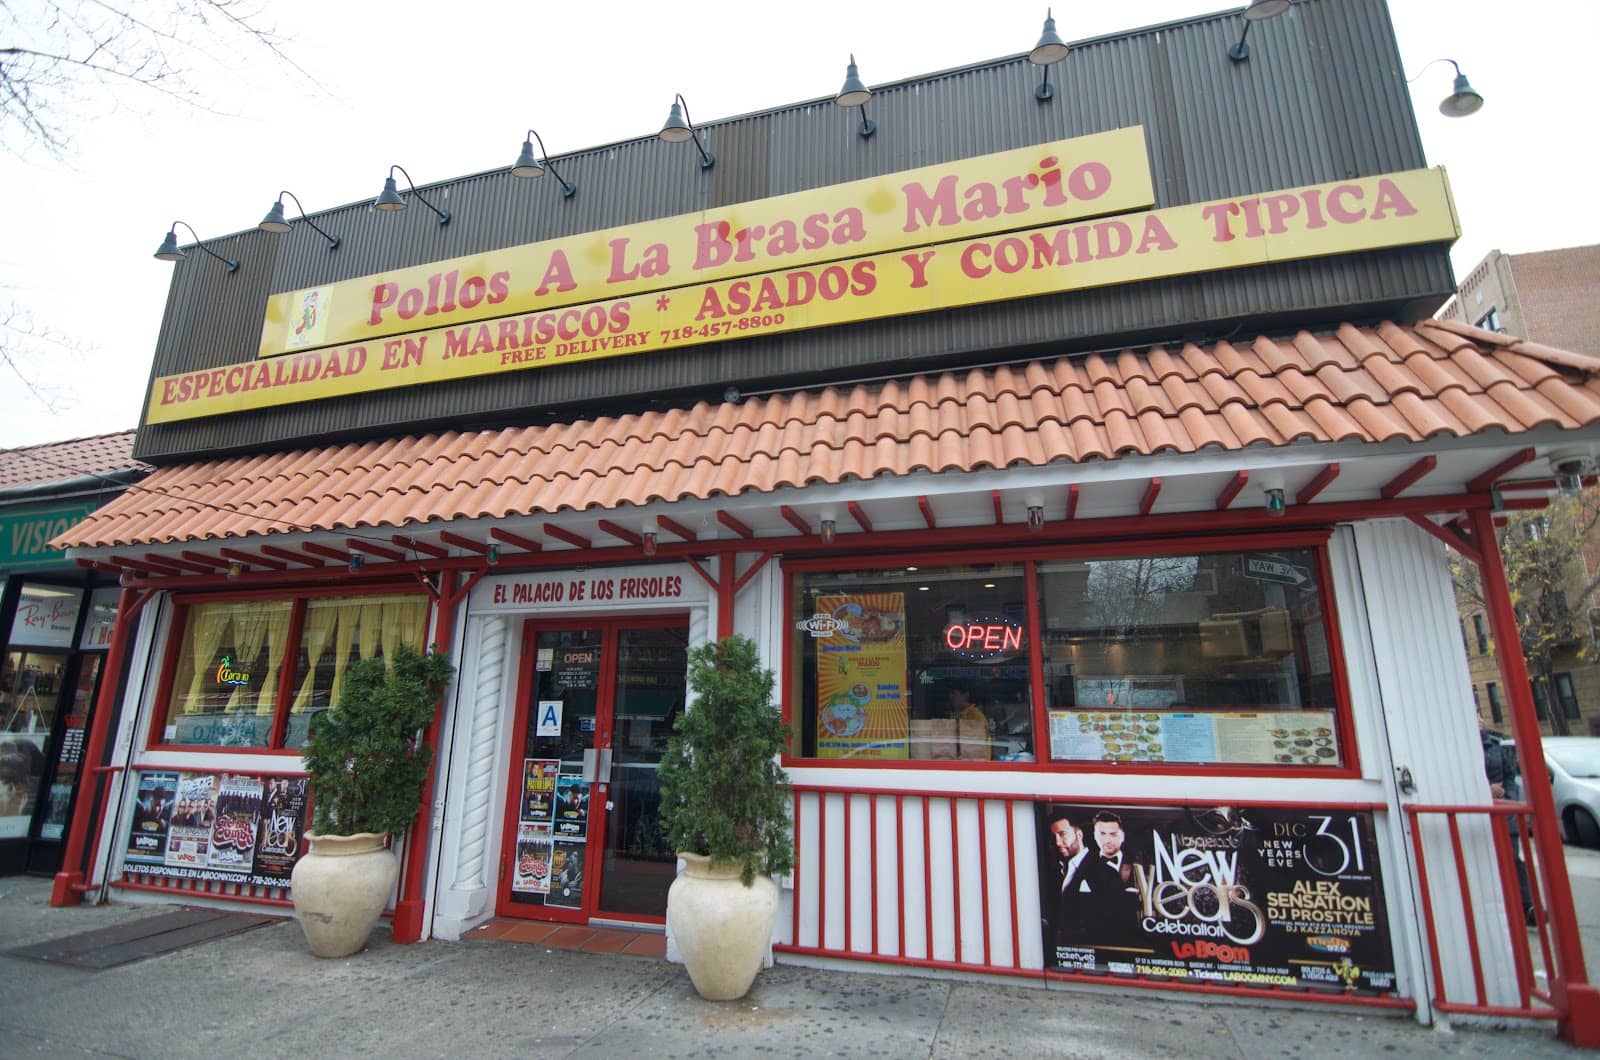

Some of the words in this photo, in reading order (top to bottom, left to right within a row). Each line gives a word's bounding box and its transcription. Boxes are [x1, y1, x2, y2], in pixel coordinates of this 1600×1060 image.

[368, 269, 510, 327] Pollos
[535, 249, 578, 297] A
[606, 238, 670, 284] La
[692, 206, 867, 271] Brasa
[902, 156, 1112, 233] Mario
[160, 346, 367, 405] ESPECIALIDAD
[380, 336, 428, 370] EN
[442, 301, 631, 360] MARISCOS
[694, 261, 877, 321] ASADOS
[901, 251, 936, 289] Y
[960, 215, 1178, 280] COMIDA
[1203, 179, 1418, 243] TIPICA
[500, 347, 547, 366] FREE
[554, 331, 651, 357] DELIVERY
[660, 313, 785, 344] 718-457-8800
[11, 517, 80, 555] VISIO
[493, 584, 507, 604] EL
[512, 582, 563, 603] PALACIO
[569, 581, 586, 601] DE
[590, 579, 614, 600] LOS
[619, 576, 682, 599] FRISOLES
[809, 619, 836, 631] Wi-Fi
[946, 625, 1022, 650] OPEN
[564, 652, 593, 664] OPEN
[542, 705, 558, 727] A
[1258, 849, 1302, 859] YEARS
[1263, 839, 1293, 849] NEW
[1273, 822, 1308, 837] DIC
[1302, 815, 1364, 876] 31
[1153, 829, 1238, 890] New
[1268, 859, 1294, 868] EVE
[150, 866, 187, 878] DISPONIBLES
[188, 869, 196, 878] EN
[1292, 880, 1342, 897] ALEX
[1133, 863, 1266, 946] Years
[1266, 891, 1370, 911] SENSATION
[1267, 907, 1287, 920] DJ
[1291, 908, 1375, 925] PROSTYLE
[1142, 917, 1225, 937] Celebration
[1286, 925, 1298, 933] DJ
[1300, 926, 1361, 937] KAZZANOVA
[1193, 969, 1223, 980] Tickets
[1224, 971, 1298, 985] LABOOMNY.COM
